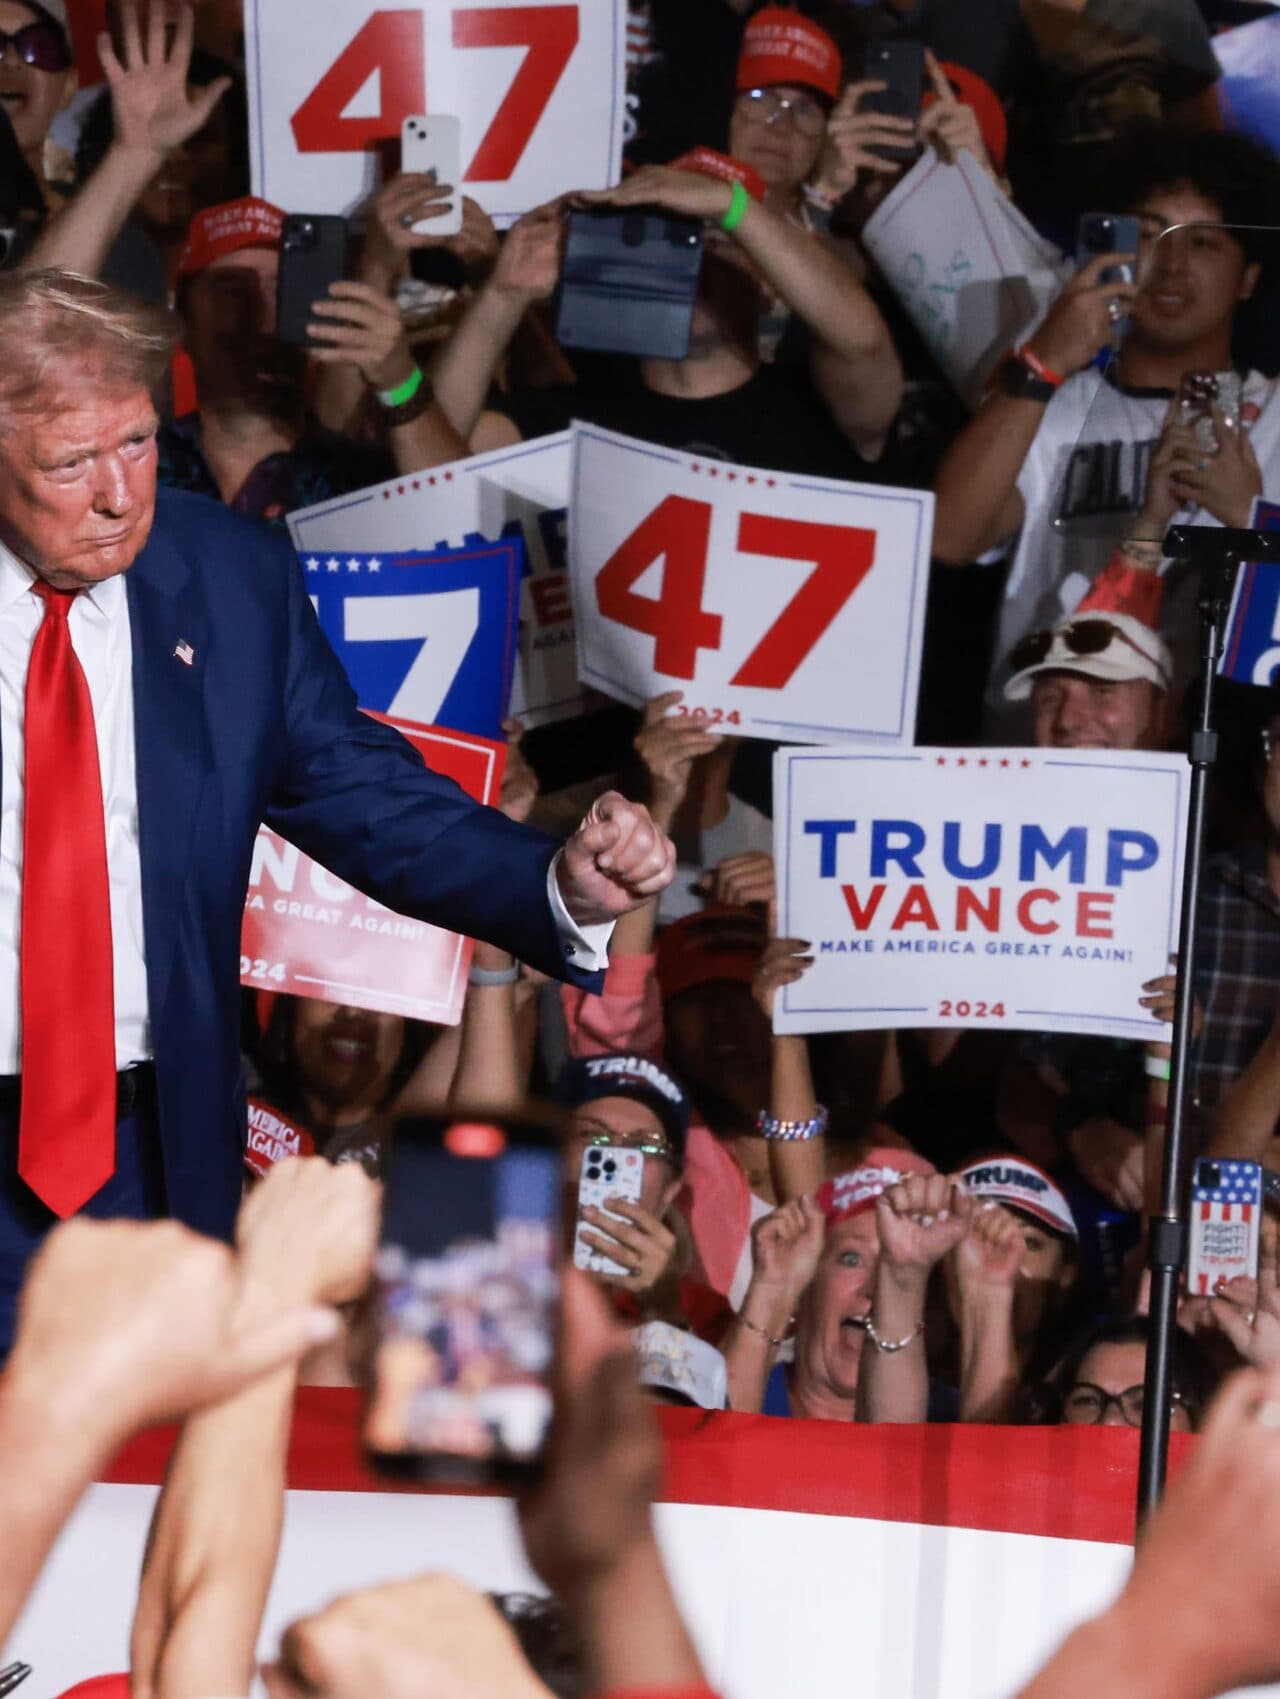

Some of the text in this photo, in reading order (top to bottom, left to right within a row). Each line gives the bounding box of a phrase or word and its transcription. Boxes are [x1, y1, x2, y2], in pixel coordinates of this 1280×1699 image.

[290, 5, 580, 184] 47
[594, 494, 877, 691] 47
[310, 587, 480, 726] 7
[803, 819, 1160, 887] TRUMP
[273, 899, 343, 925] GREAT
[349, 913, 425, 942] AGAIN!
[840, 883, 1115, 939] VANCE
[240, 955, 287, 981] 024
[820, 940, 1133, 962] MAKE AMERICA GREAT AGAIN!
[938, 1000, 1006, 1018] 2024
[585, 1056, 682, 1103] TRUMP
[247, 1104, 301, 1155] MERICA
[963, 1165, 1049, 1192] TRUMP
